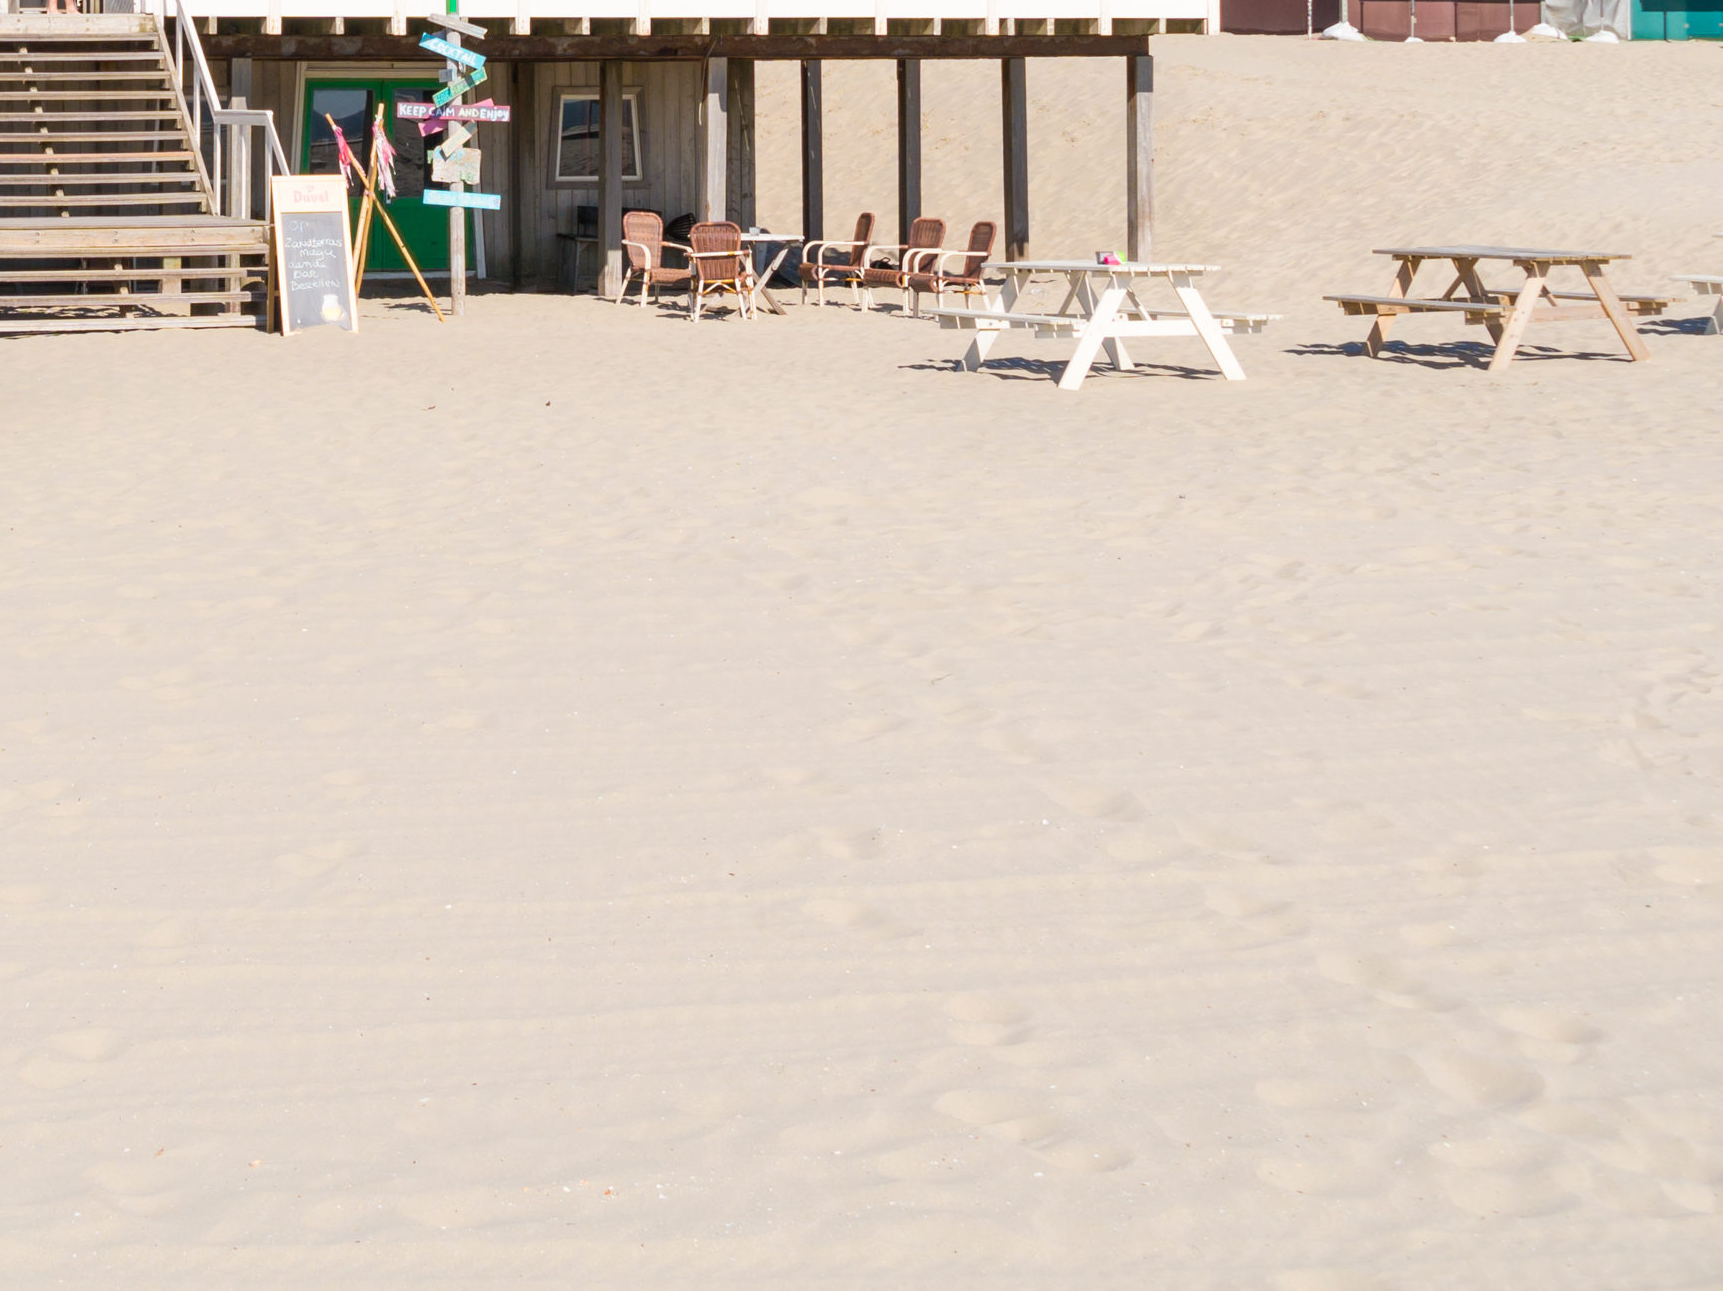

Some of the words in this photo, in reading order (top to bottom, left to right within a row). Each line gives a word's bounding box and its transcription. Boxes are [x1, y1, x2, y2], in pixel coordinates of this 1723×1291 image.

[399, 102, 427, 117] KEEP
[458, 108, 479, 118] AND
[293, 190, 329, 203] Duvel
